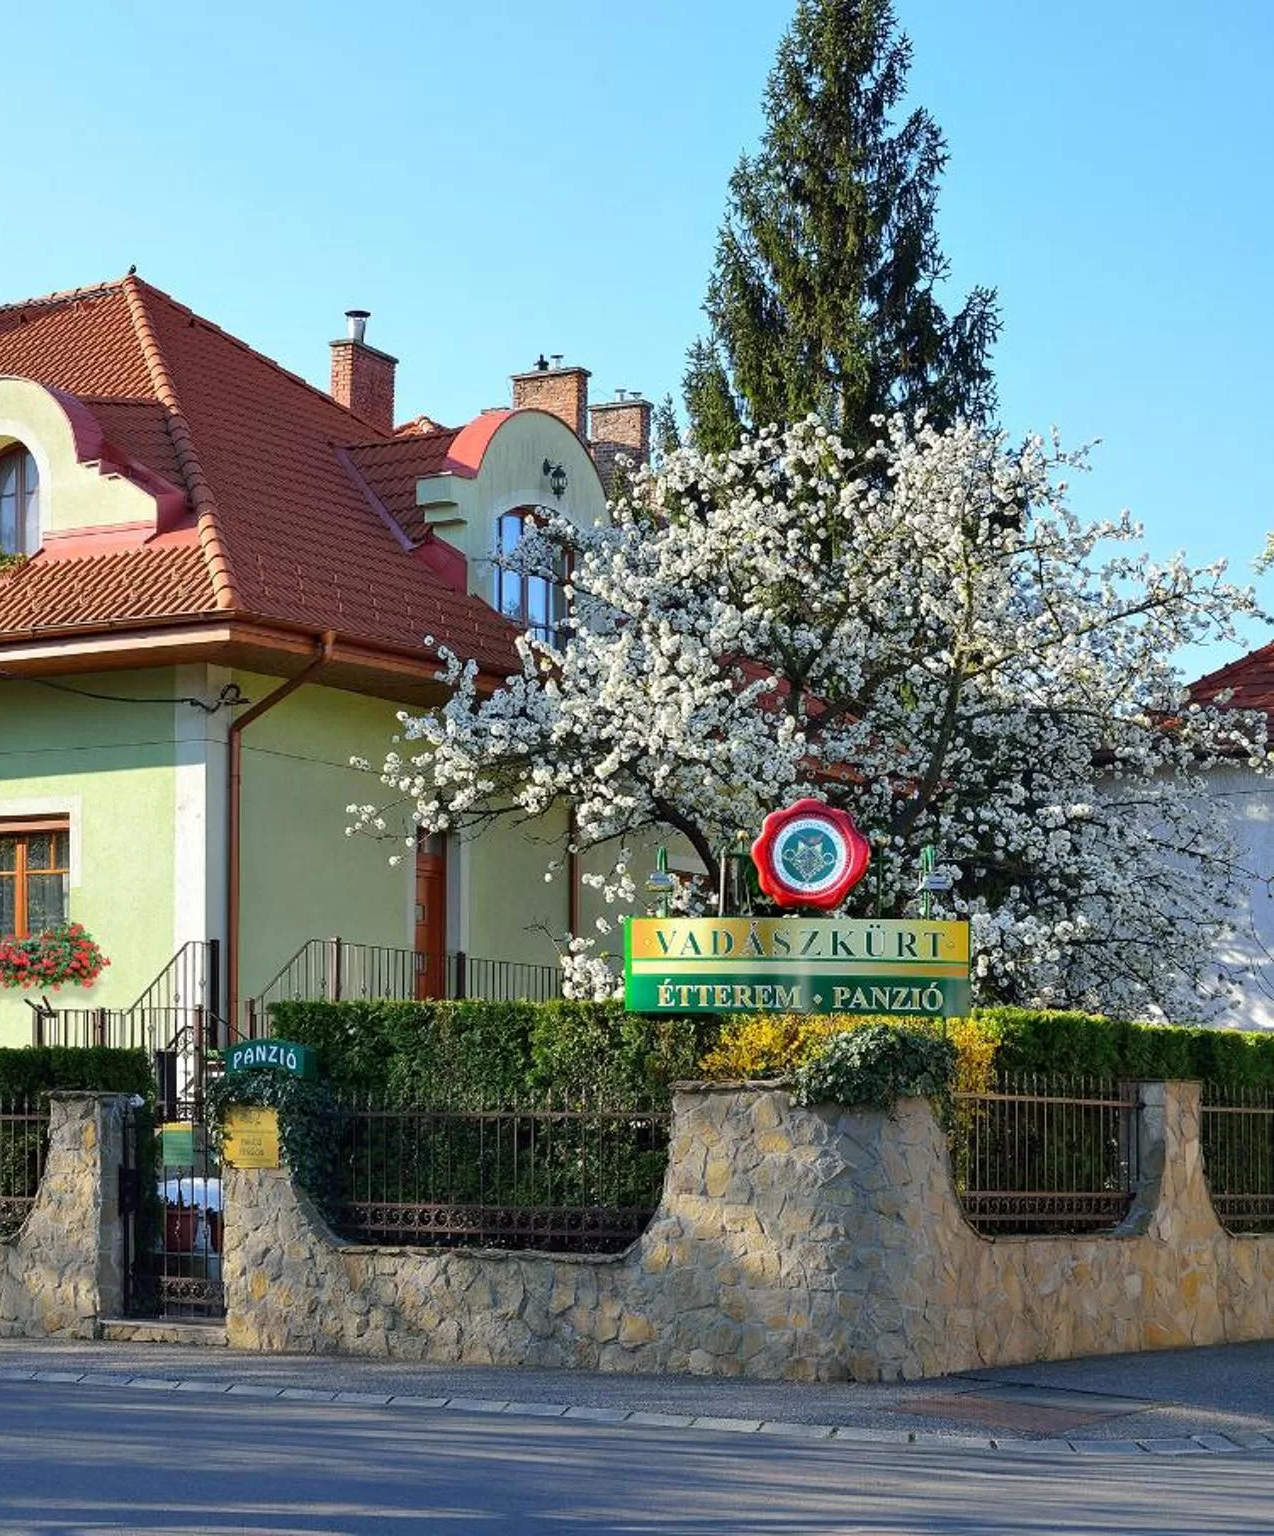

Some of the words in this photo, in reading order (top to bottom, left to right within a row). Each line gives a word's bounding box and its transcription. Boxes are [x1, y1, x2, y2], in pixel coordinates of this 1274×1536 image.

[656, 921, 944, 958] VADÁSZKÜRT
[657, 978, 802, 1008] ÉTTEREM
[832, 981, 944, 1010] PANZIÓ
[233, 1045, 296, 1069] PANZIÓ
